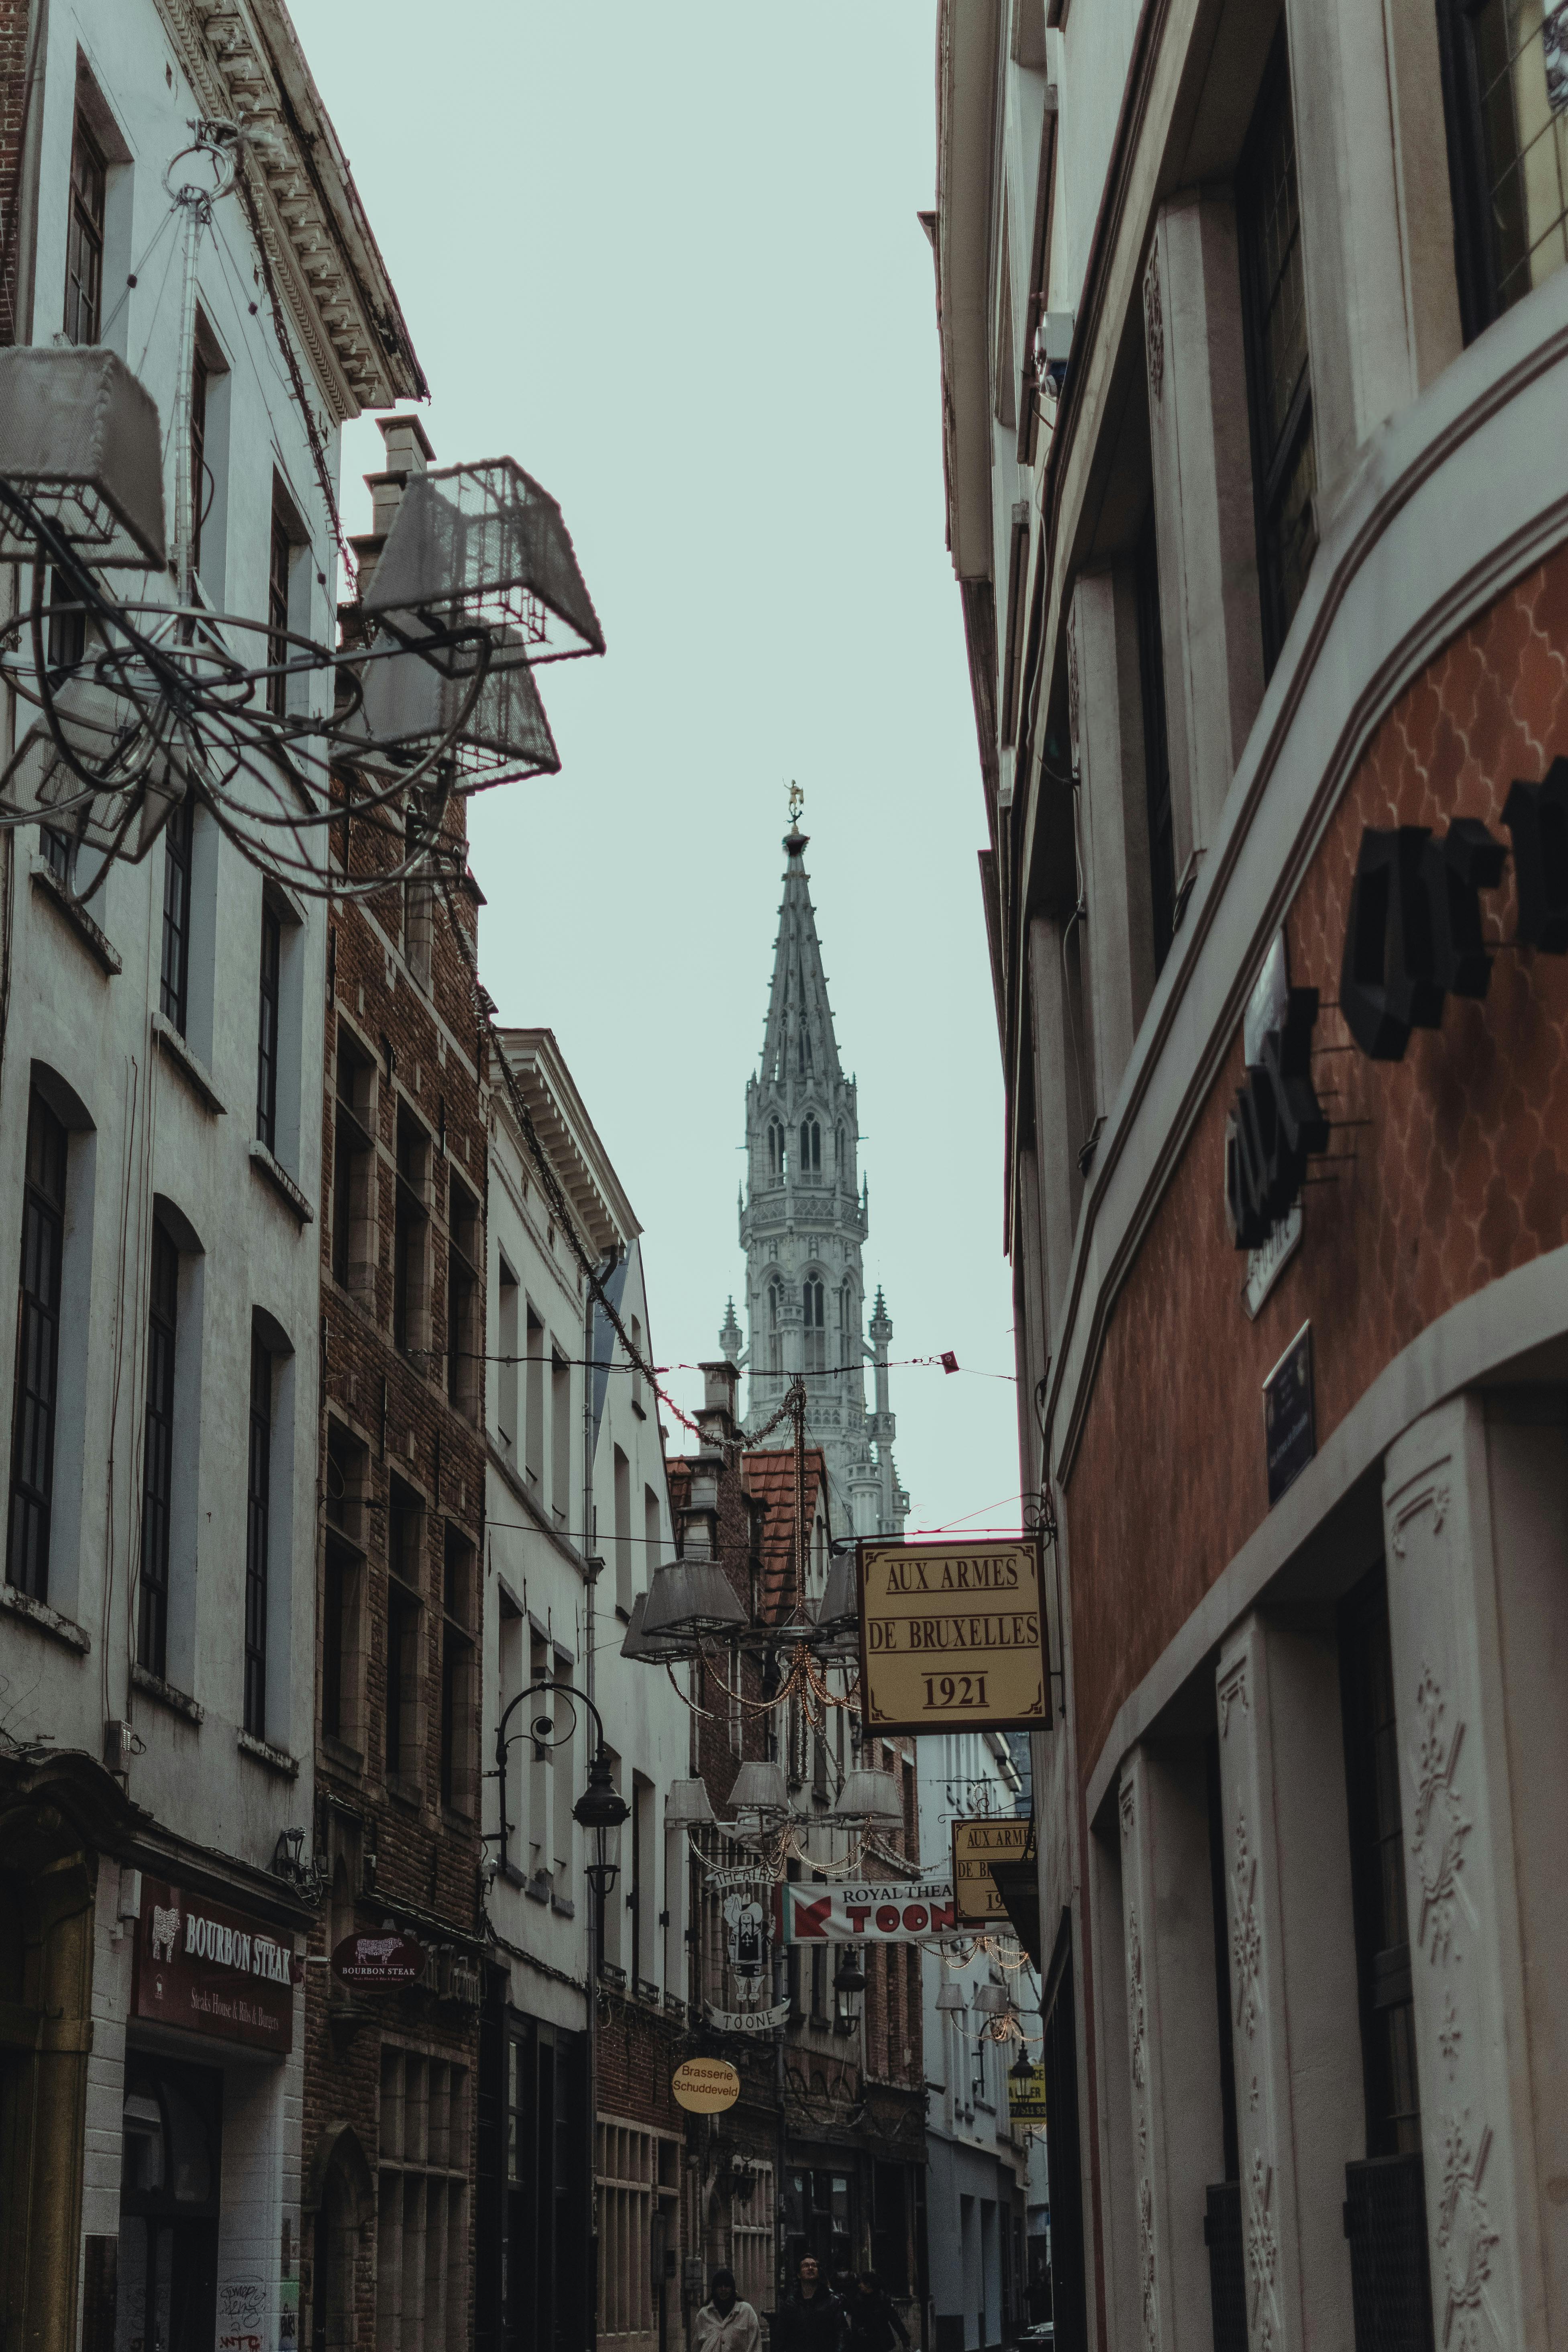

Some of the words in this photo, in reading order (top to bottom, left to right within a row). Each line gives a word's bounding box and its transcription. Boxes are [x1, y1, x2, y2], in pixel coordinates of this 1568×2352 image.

[887, 1562, 929, 1591] AUX
[941, 1558, 1018, 1587] ARMES
[869, 1622, 896, 1649] DE
[910, 1616, 1039, 1648] BRUXELLES
[923, 1676, 987, 1706] 1921
[967, 1830, 990, 1846] AUX
[958, 1862, 973, 1877] DE
[843, 1887, 903, 1903] ROYAL
[905, 1884, 953, 1898] THEA
[986, 1893, 1003, 1909] 19
[184, 1913, 251, 1973] BOURBON
[253, 1938, 291, 1986] STEAK
[342, 1967, 385, 1975] BOURBON
[387, 1968, 416, 1976] STEAK
[191, 1987, 211, 2012] Steaks
[212, 1993, 231, 2018] House
[232, 1999, 237, 2020] &
[239, 2001, 251, 2023] Ribs
[252, 2005, 257, 2025] &
[258, 2007, 279, 2033] Burgers
[724, 2011, 775, 2029] TOONE
[682, 2065, 733, 2081] Brasserie
[673, 2080, 738, 2097] Schuddeveld
